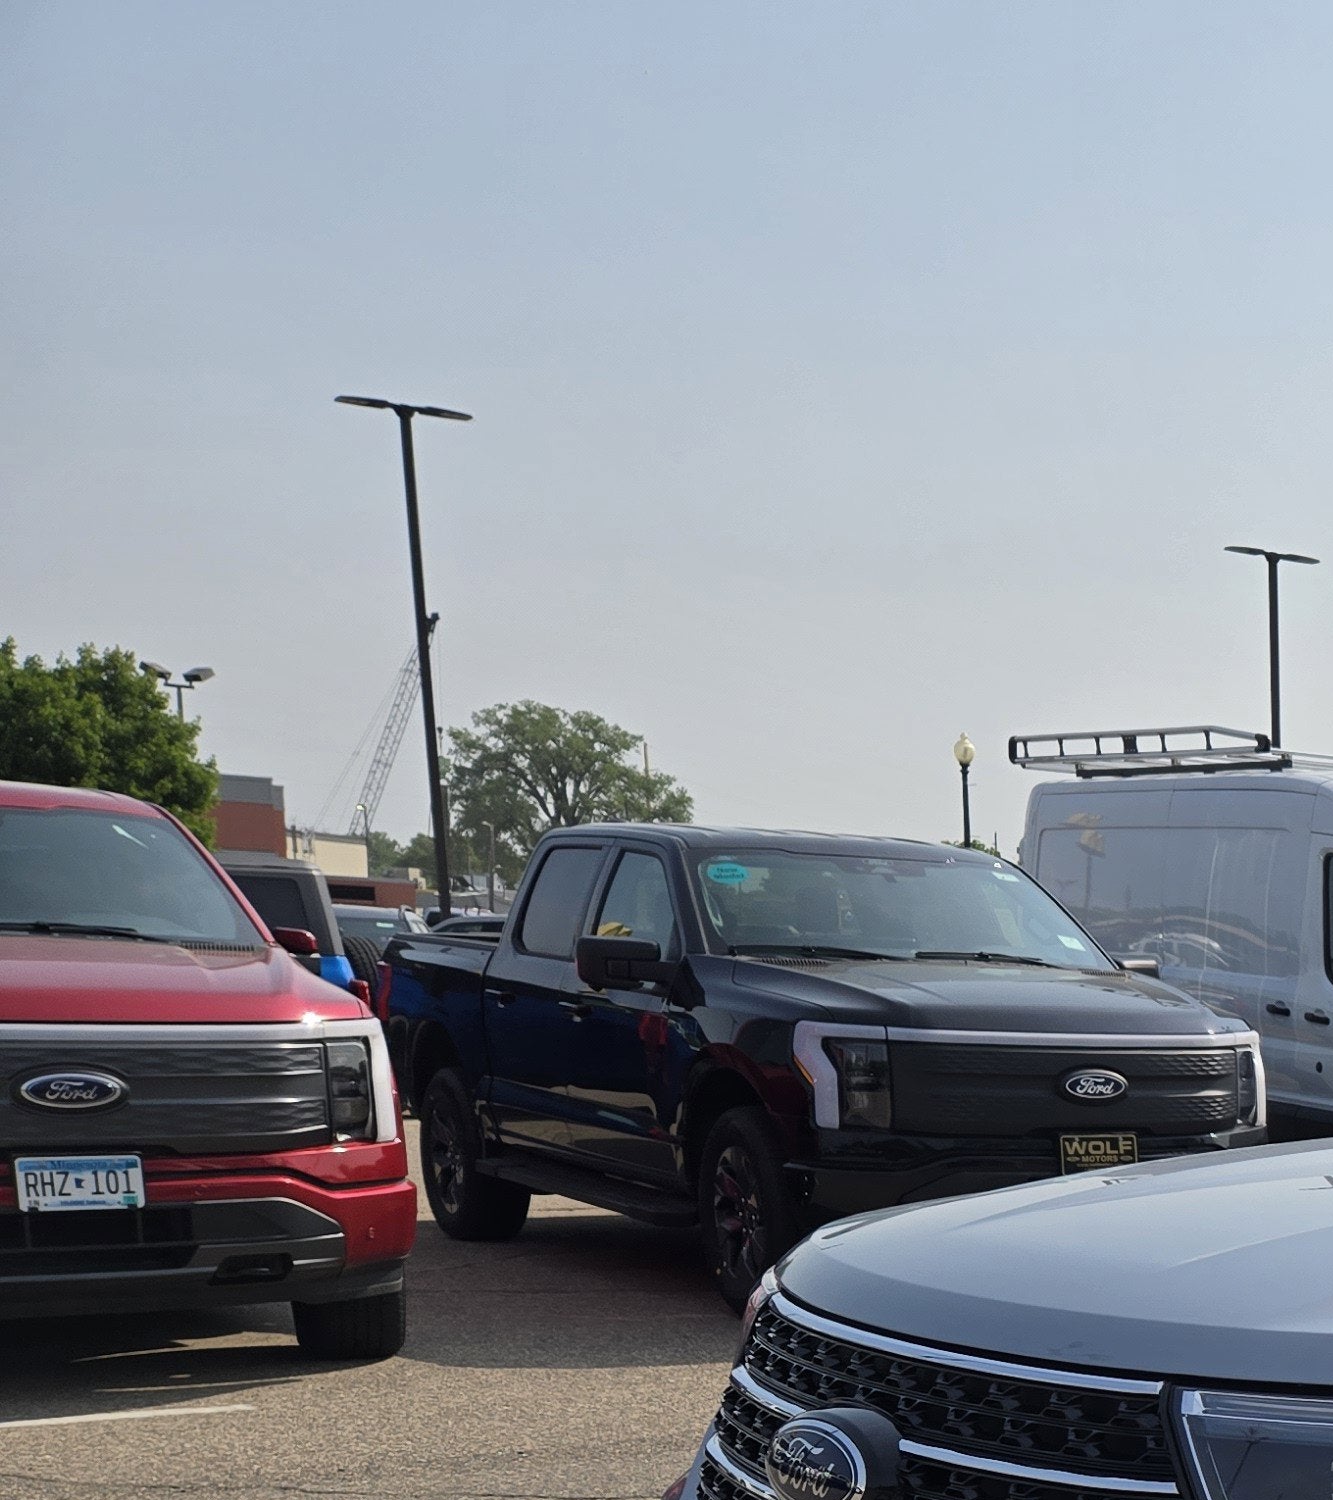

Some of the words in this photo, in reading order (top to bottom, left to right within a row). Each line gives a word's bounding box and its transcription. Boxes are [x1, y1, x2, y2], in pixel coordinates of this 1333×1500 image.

[45, 1080, 97, 1100] Ford
[1076, 1077, 1115, 1094] Ford
[1064, 1141, 1132, 1155] WOLF
[1081, 1155, 1118, 1163] MOTORS
[24, 1171, 72, 1198] RHZ
[92, 1169, 136, 1195] 101
[778, 1437, 835, 1498] Ford
